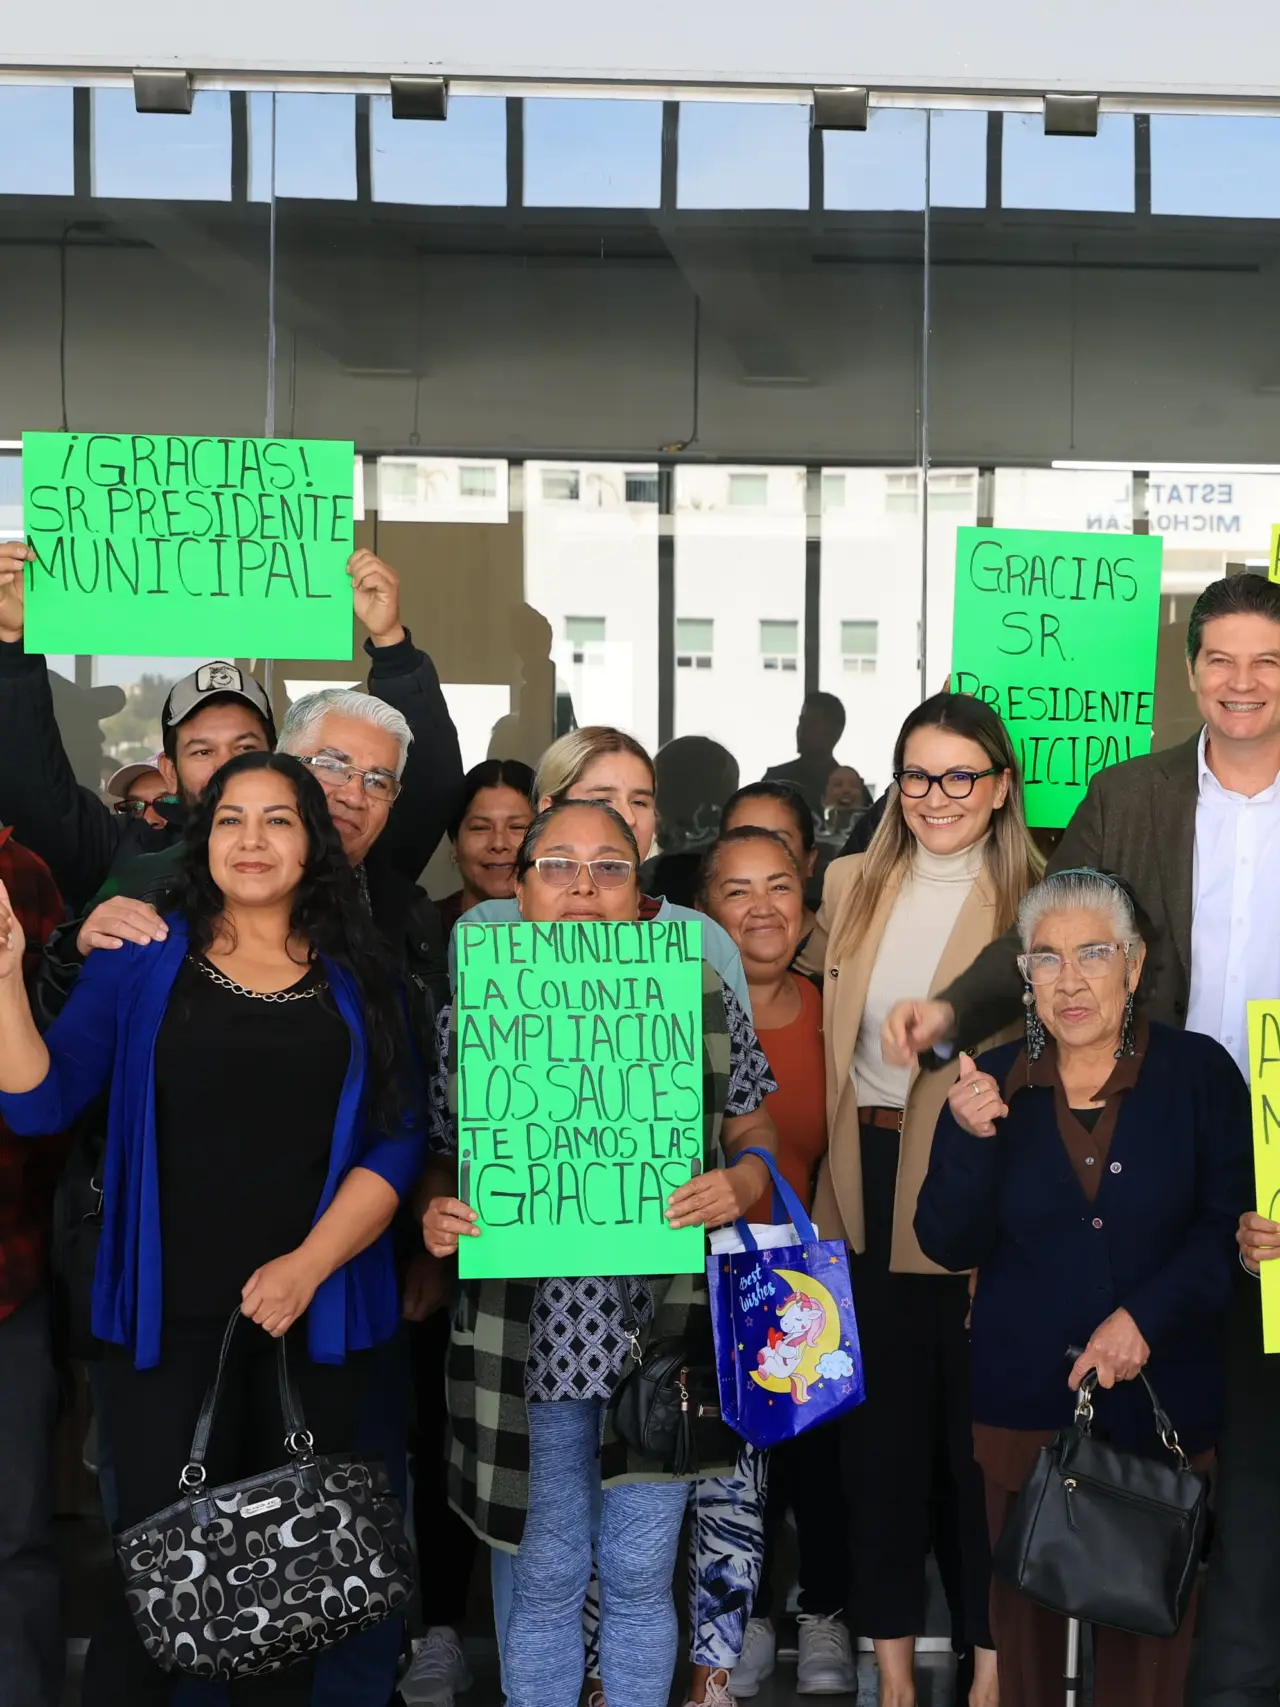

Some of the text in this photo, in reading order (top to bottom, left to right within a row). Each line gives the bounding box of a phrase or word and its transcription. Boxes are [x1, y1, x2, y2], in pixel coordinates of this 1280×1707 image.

[61, 434, 314, 491] ¡GRACIAS!
[29, 485, 354, 542] SR. PRESIDENTE
[26, 534, 332, 598] MUNICIPAL
[969, 540, 1138, 602] GRACIAS
[997, 611, 1073, 662] SR.
[460, 920, 706, 966] PTE MUNICIPAL
[460, 968, 664, 1011] LA COLONIA
[460, 1011, 695, 1063] AMPLIACION
[460, 1061, 701, 1123] LOS SAUCES
[462, 1123, 701, 1161] TE DAMOS LAS
